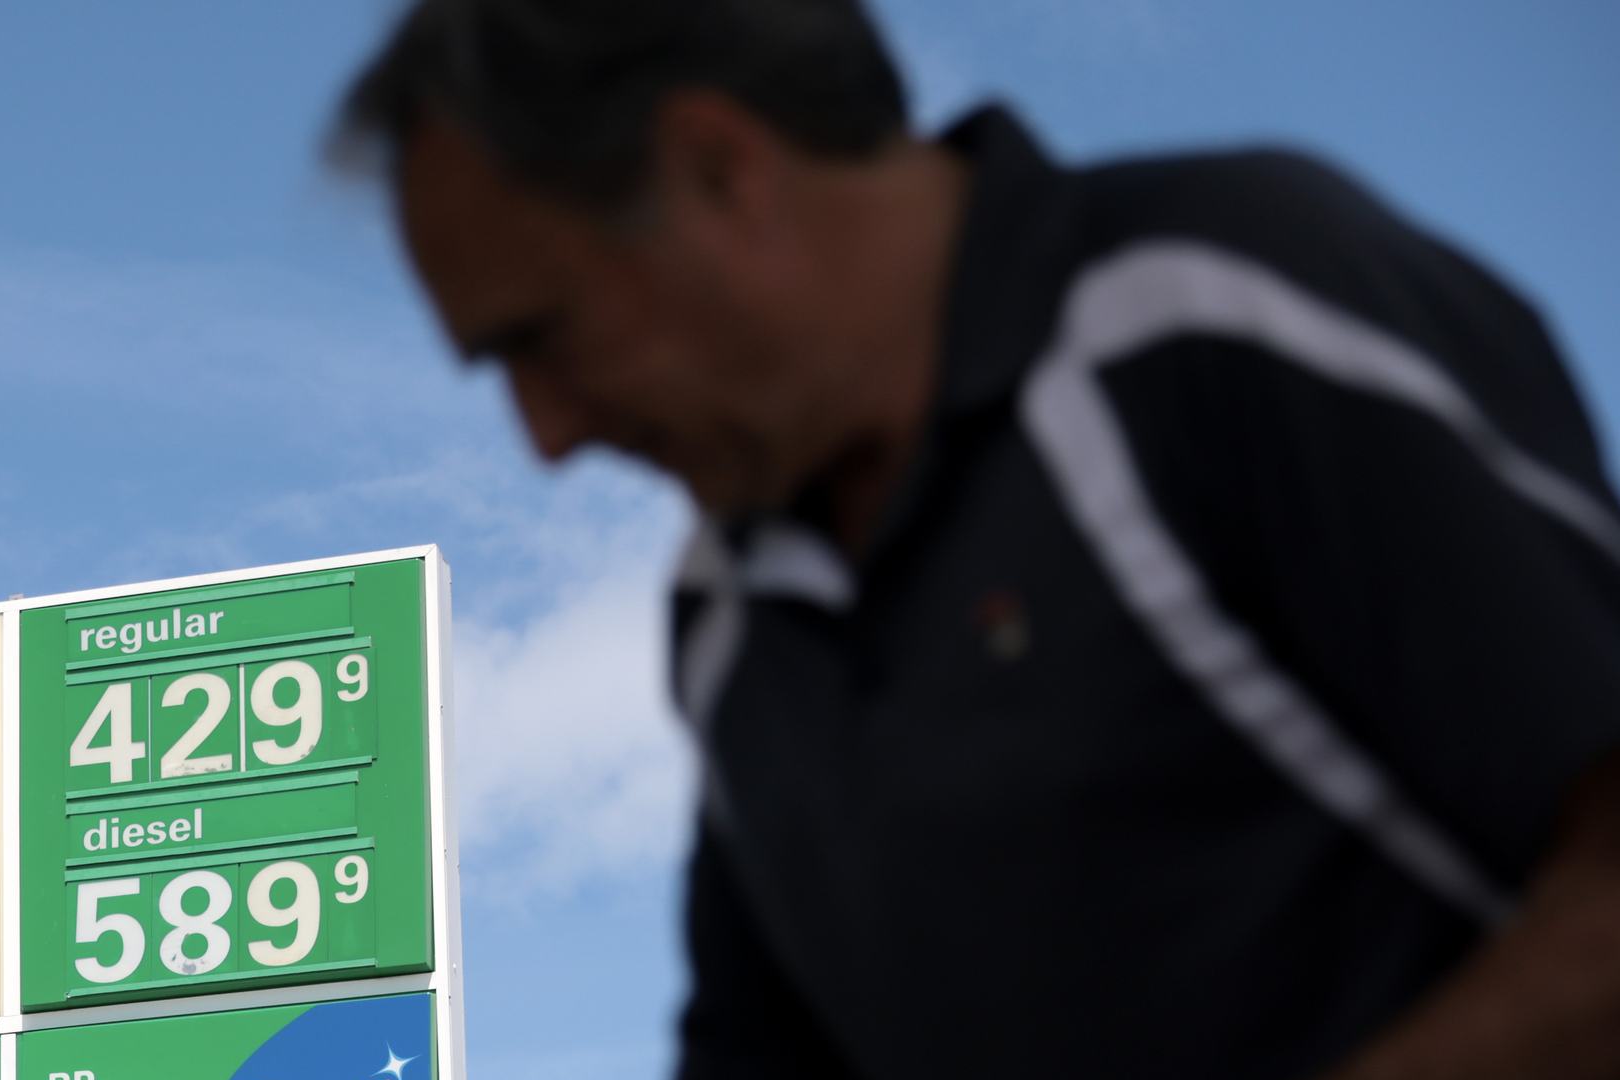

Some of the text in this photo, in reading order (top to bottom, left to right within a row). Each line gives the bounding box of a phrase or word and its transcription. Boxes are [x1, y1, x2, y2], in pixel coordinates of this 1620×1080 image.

[80, 609, 224, 655] regular
[69, 660, 323, 784] 429
[83, 808, 203, 851] diesel
[74, 861, 321, 983] 589
